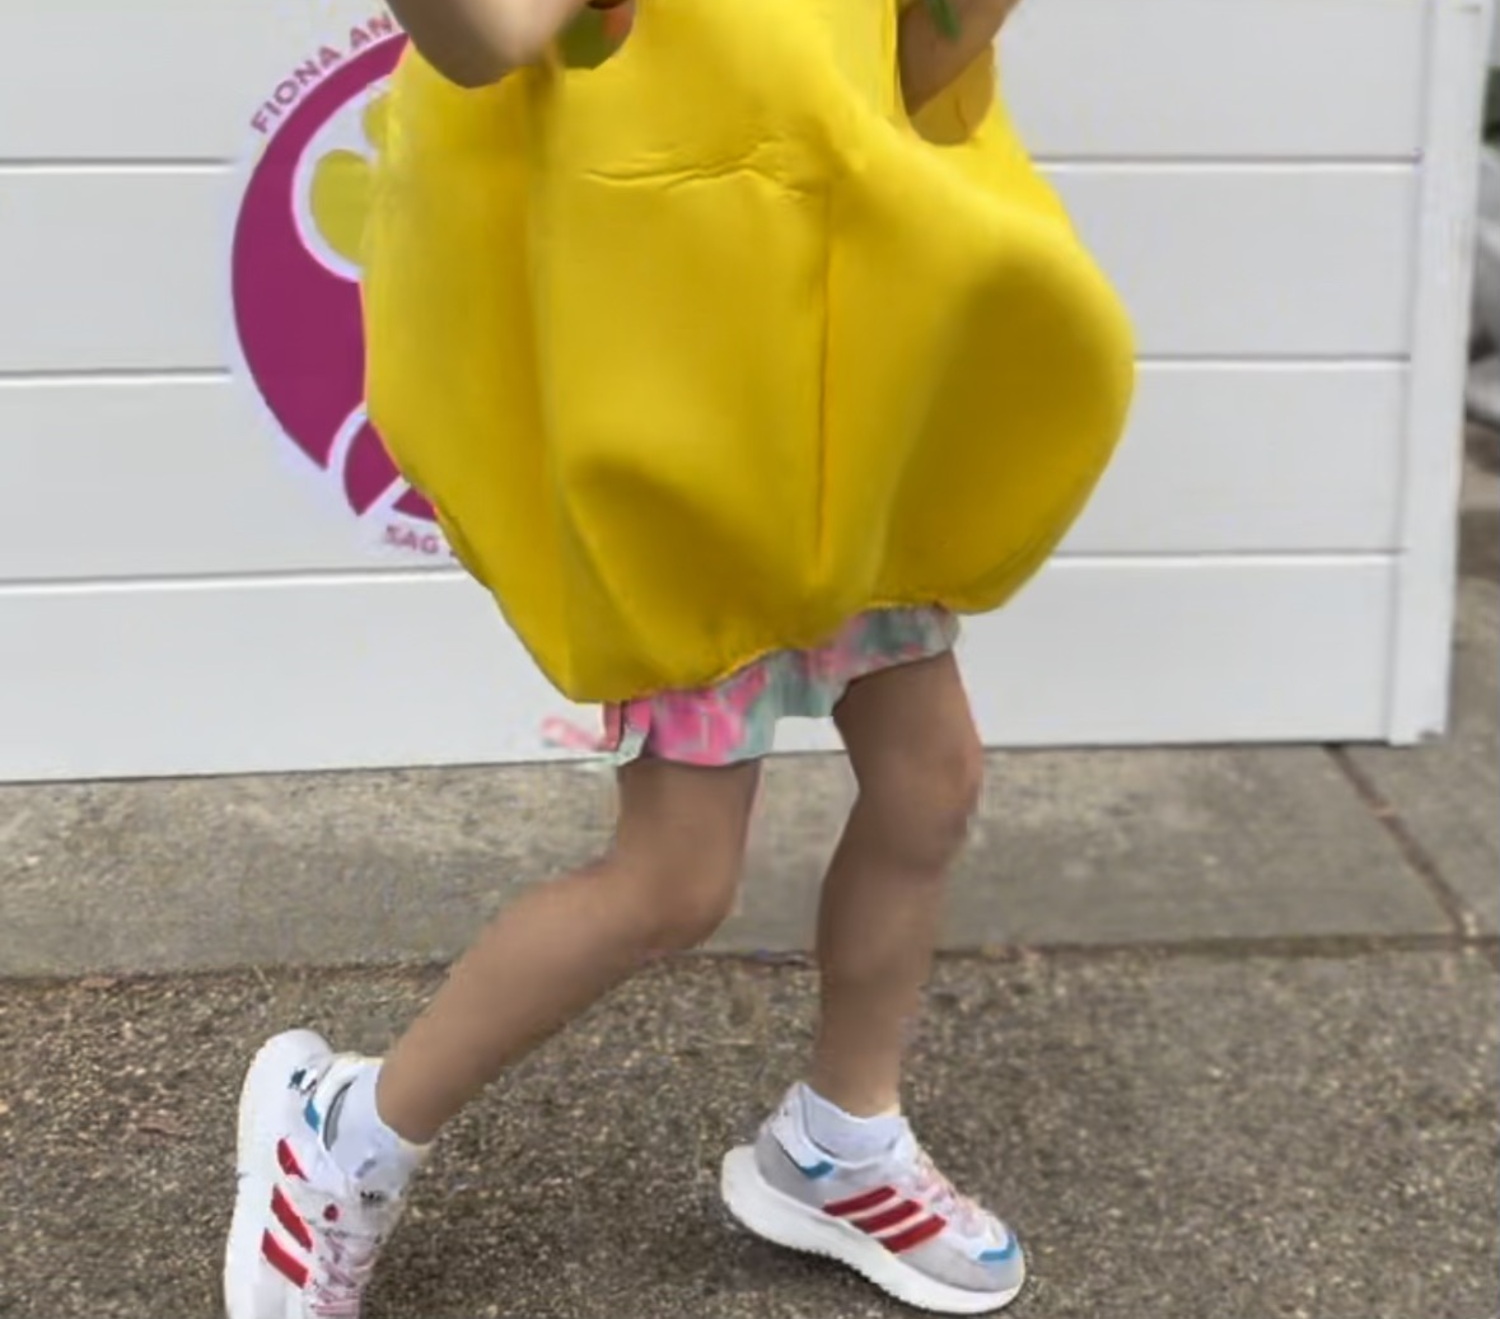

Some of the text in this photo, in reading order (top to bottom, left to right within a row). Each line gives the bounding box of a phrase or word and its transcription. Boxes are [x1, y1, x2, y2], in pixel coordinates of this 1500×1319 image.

[250, 9, 393, 134] FIONA AN
[383, 524, 440, 556] SAG
